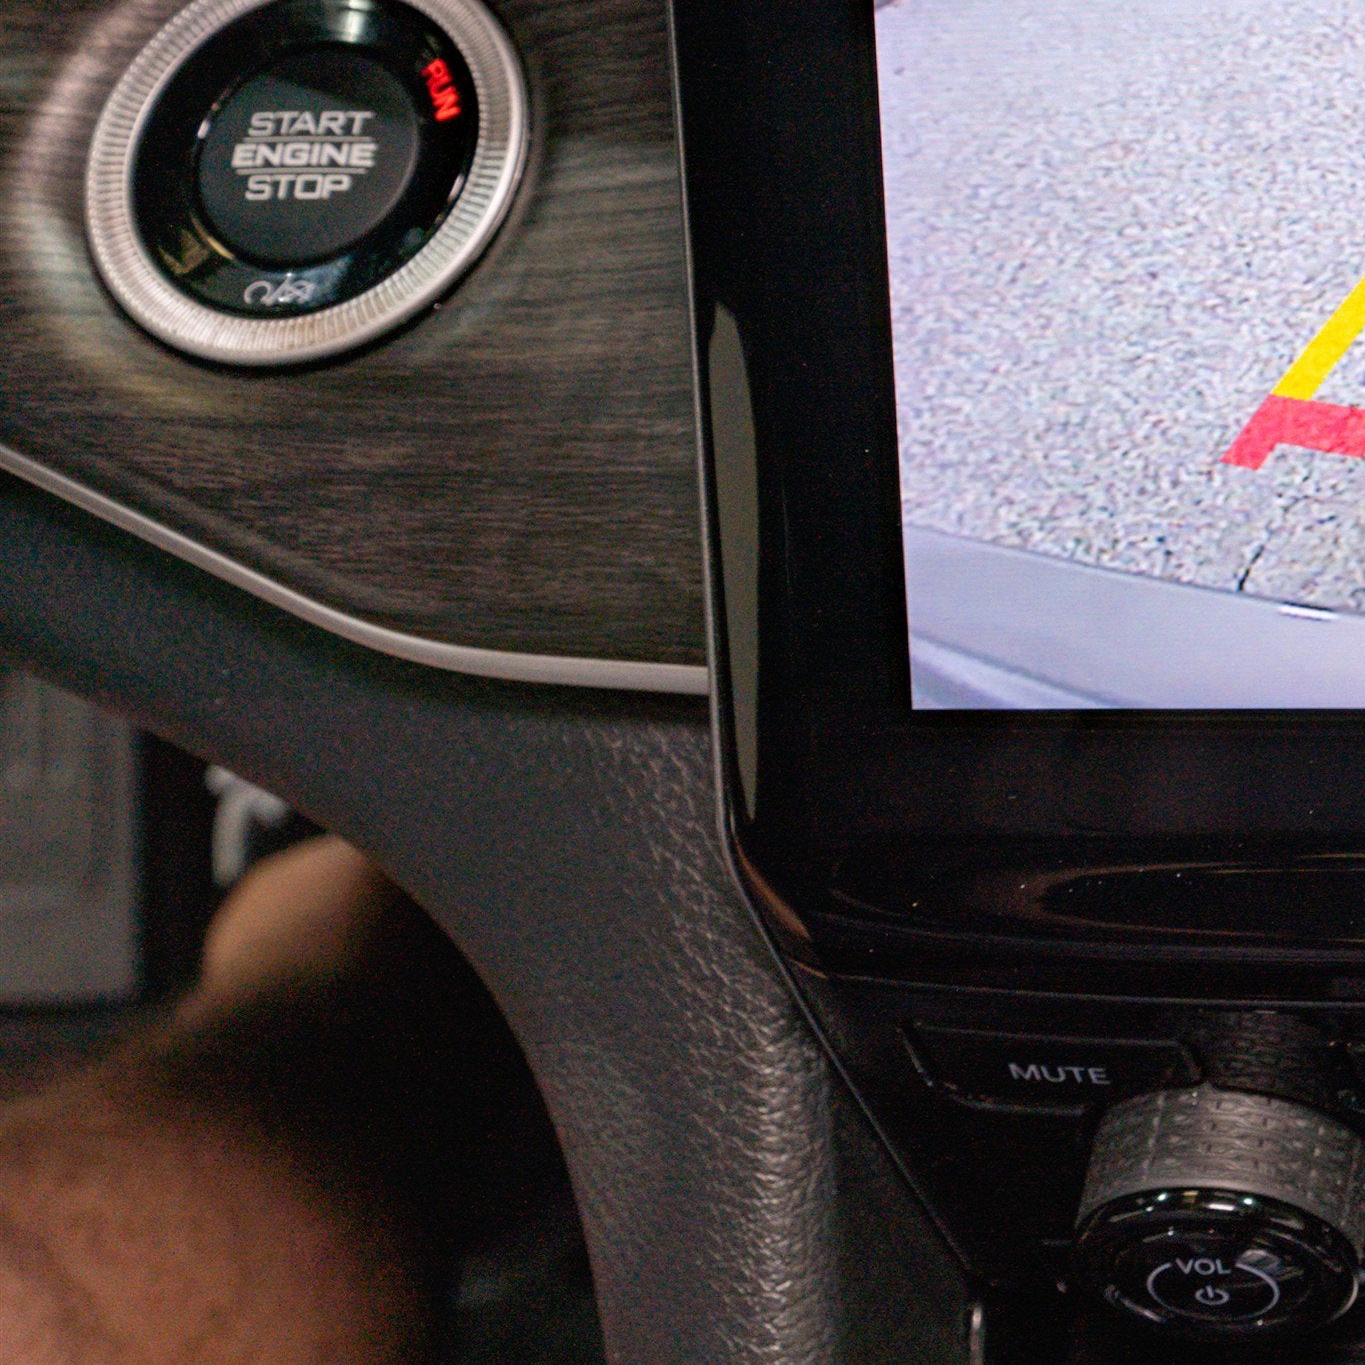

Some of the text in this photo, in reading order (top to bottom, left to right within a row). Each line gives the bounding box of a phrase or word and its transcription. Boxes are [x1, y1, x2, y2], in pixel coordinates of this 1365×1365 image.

[422, 57, 462, 122] RUN
[248, 110, 377, 137] START
[230, 142, 379, 168] ENGINE
[244, 174, 352, 201] STOP
[1008, 1061, 1111, 1085] MUTE
[1175, 1257, 1232, 1276] VOL
